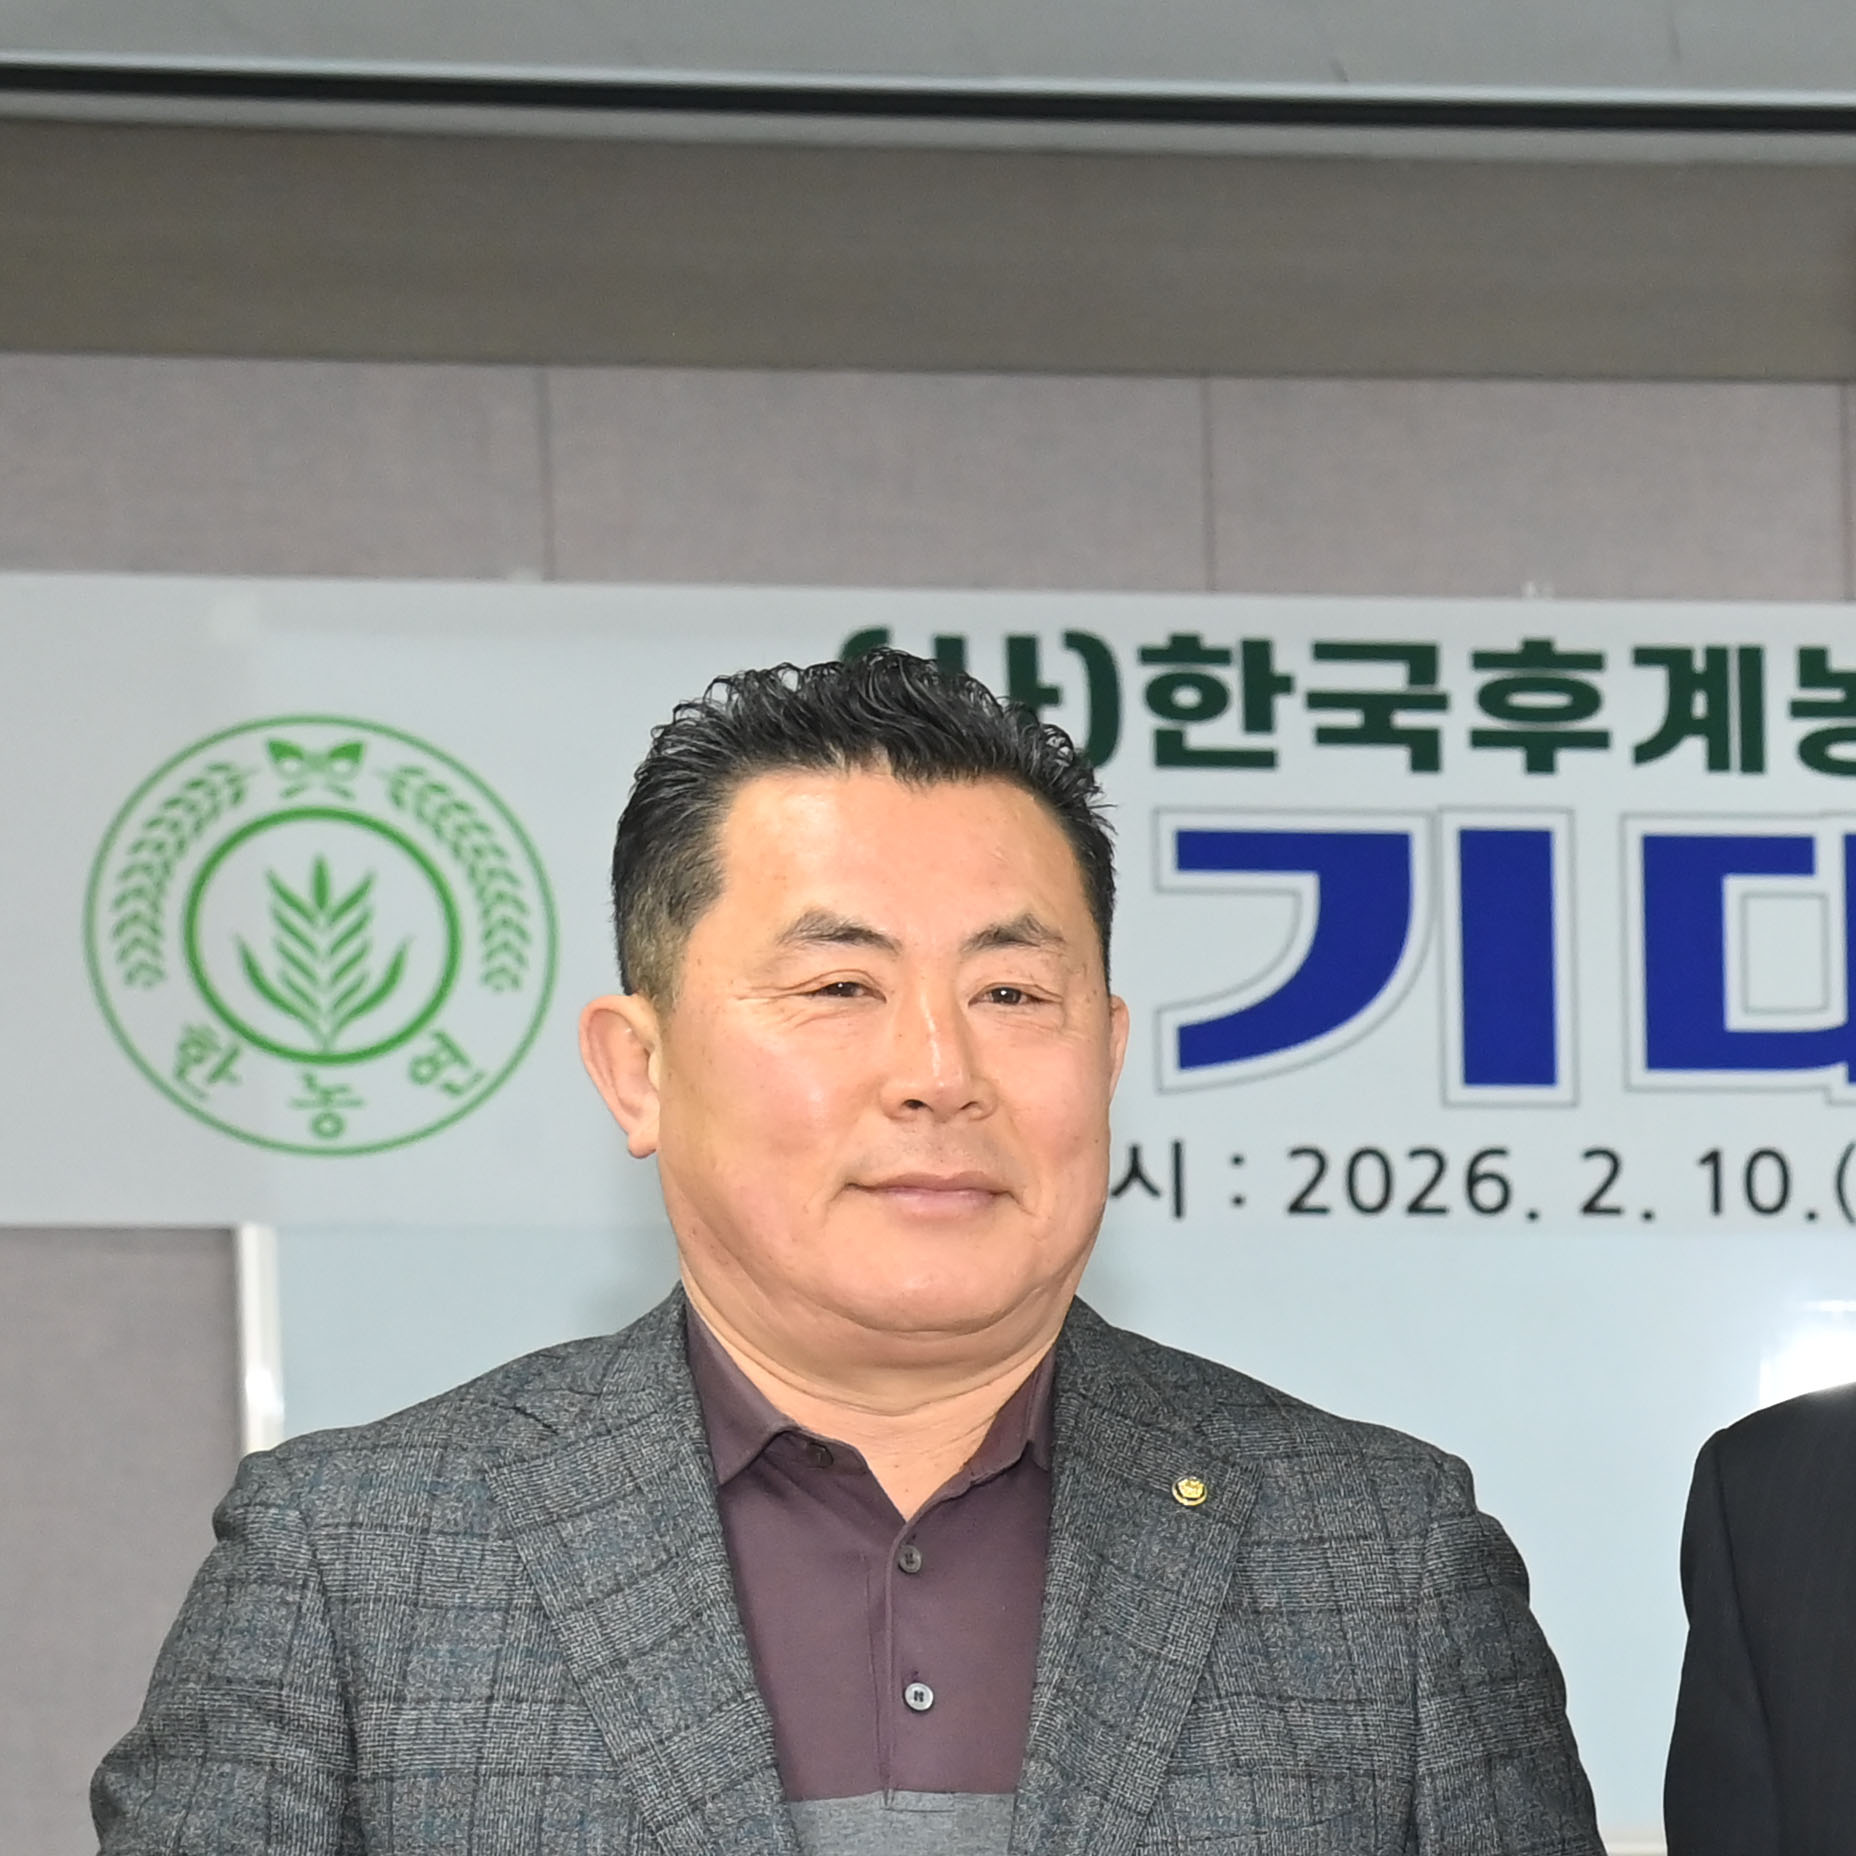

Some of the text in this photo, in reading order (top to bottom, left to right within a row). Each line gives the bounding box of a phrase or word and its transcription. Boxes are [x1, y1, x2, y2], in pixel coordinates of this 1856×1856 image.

[1111, 1141, 1186, 1220] 시
[1284, 1145, 1541, 1225] 2026.
[1578, 1145, 1656, 1225] 2.
